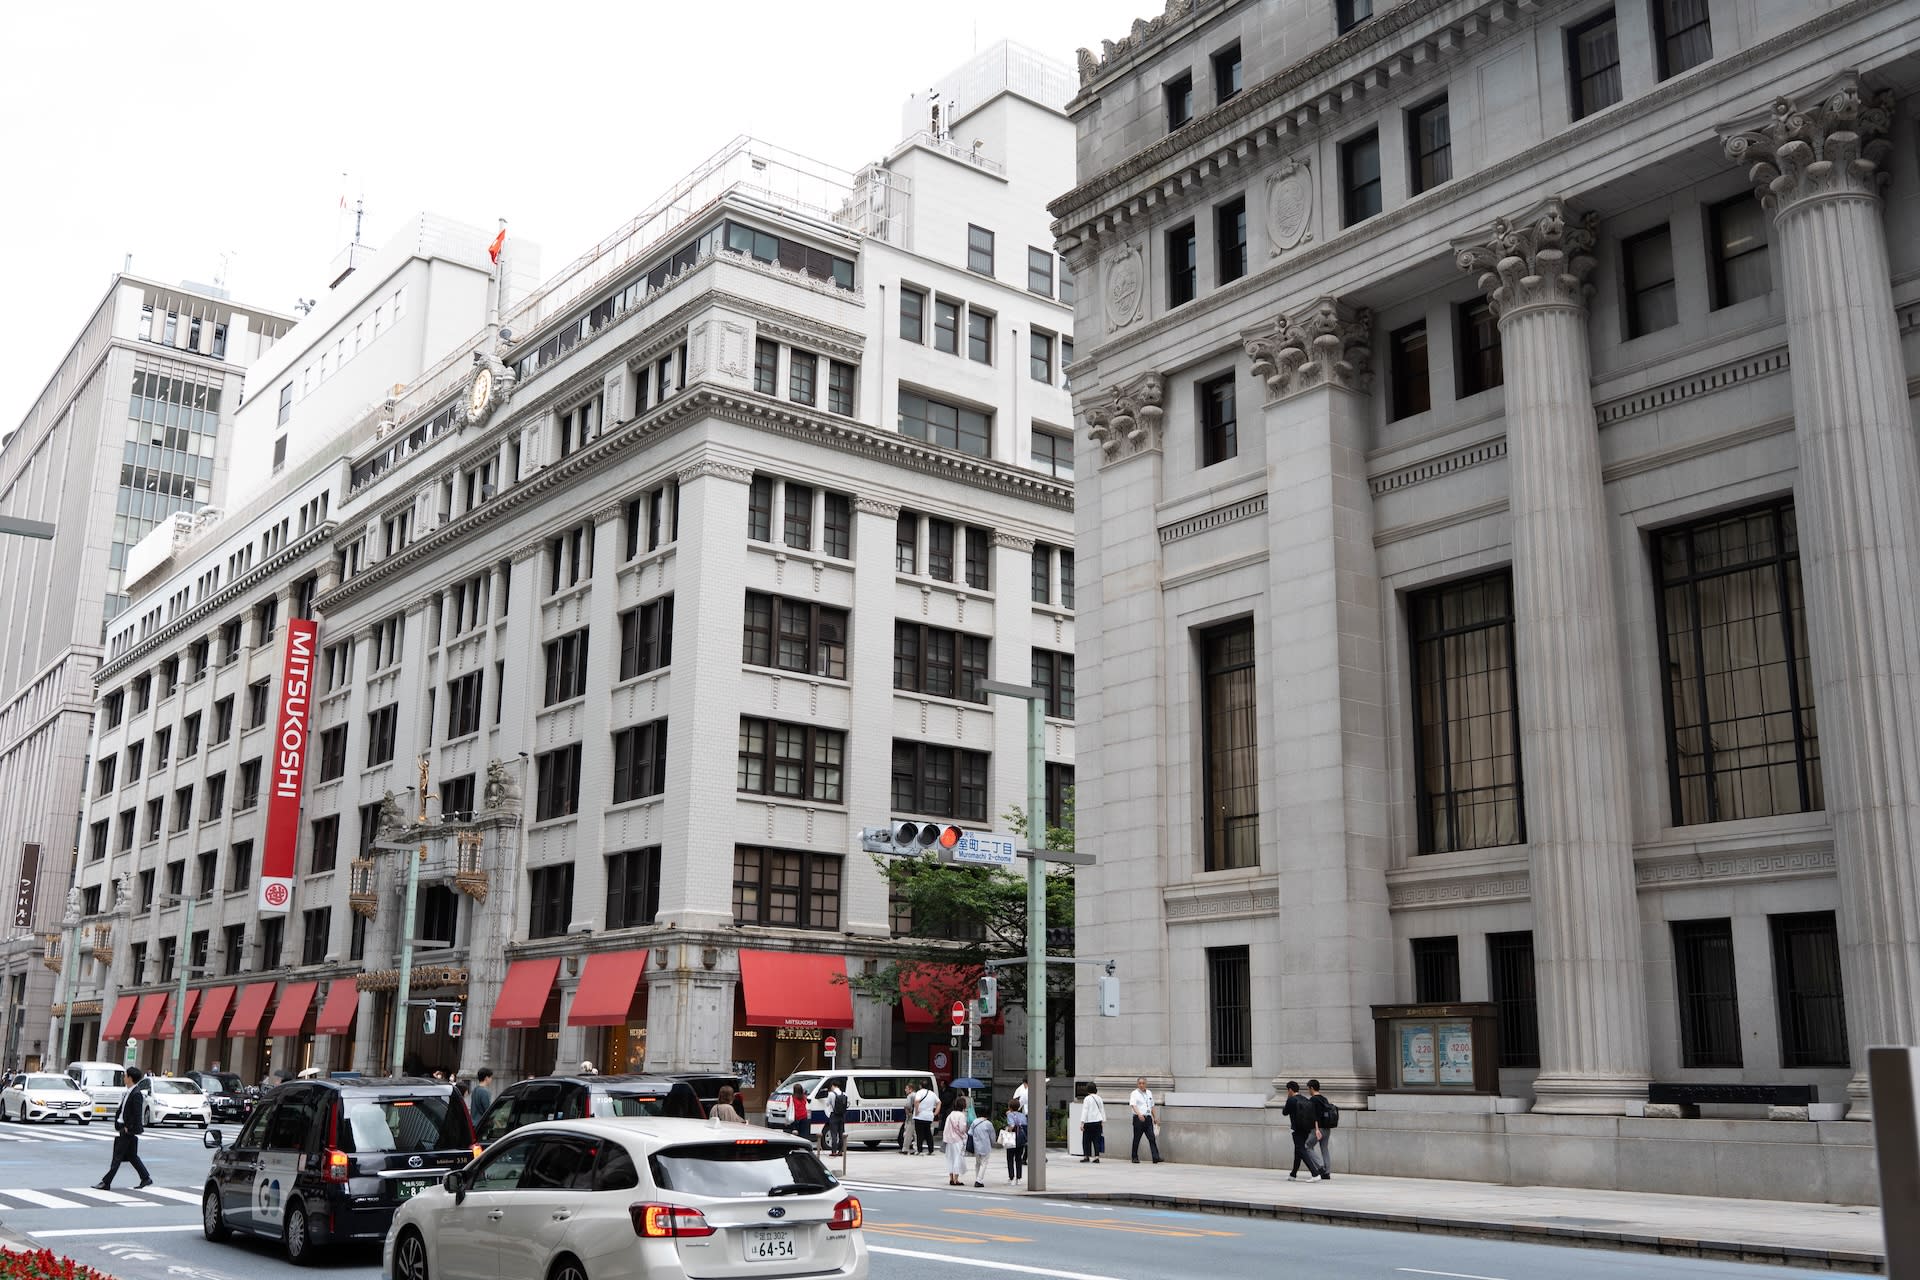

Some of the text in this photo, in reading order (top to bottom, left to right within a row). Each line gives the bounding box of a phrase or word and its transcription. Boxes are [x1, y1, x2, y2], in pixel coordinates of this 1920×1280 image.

[277, 631, 312, 798] MITSUKOSHI
[958, 838, 1012, 855] 室町二丁目
[958, 851, 1011, 862] Muromachi 2-chome
[859, 1109, 894, 1122] DANIEL
[759, 1241, 793, 1257] 64-54
